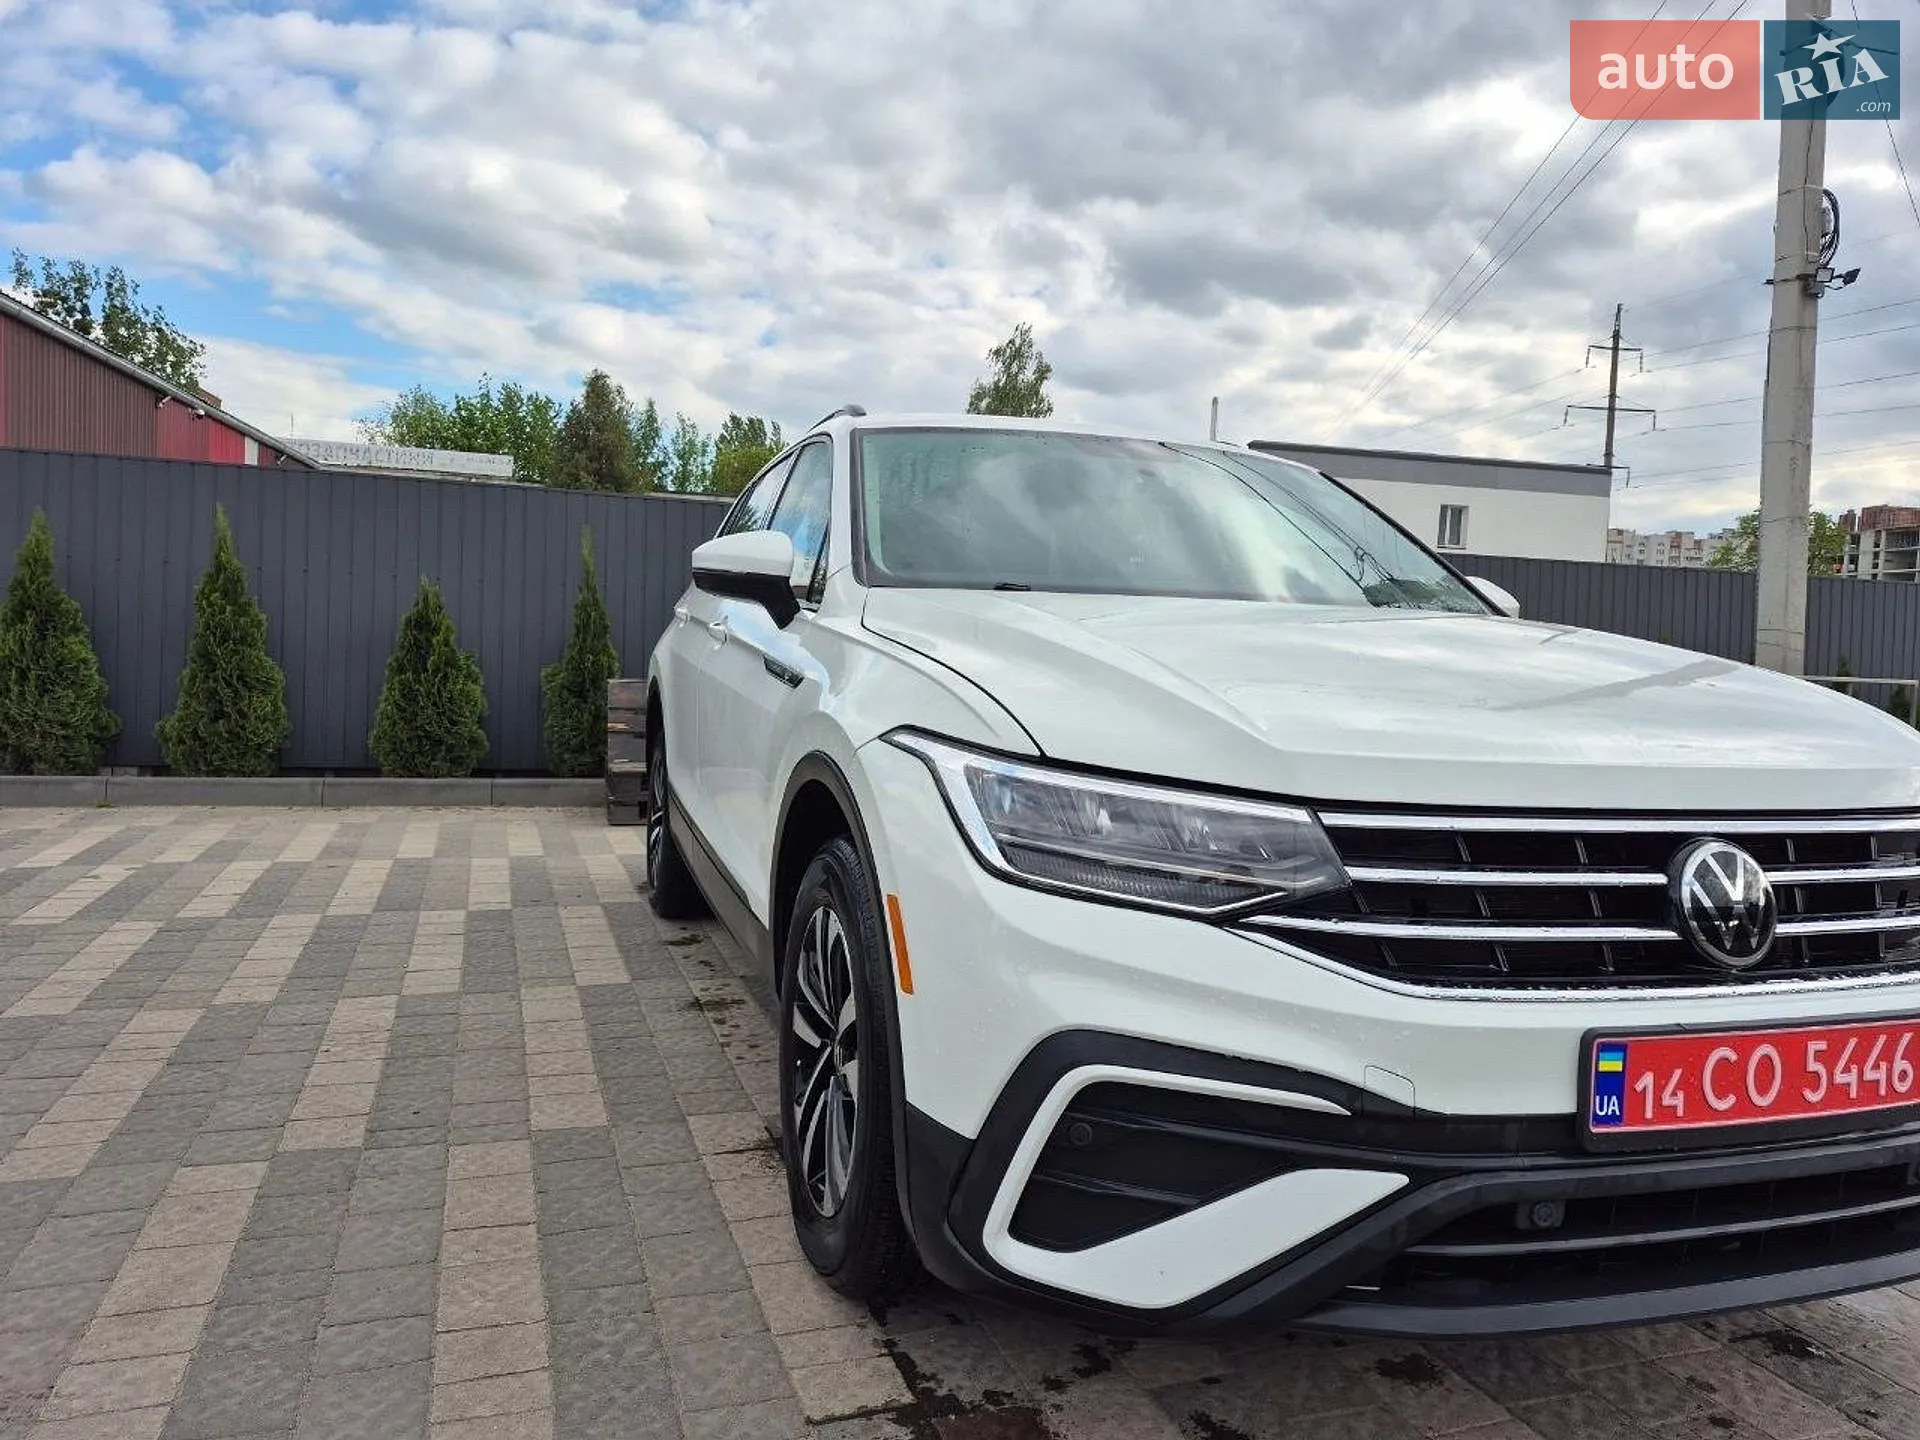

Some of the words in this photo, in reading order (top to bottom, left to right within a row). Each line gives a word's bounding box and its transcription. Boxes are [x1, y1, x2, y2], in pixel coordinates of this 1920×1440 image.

[1633, 1067, 1685, 1119] 14
[1702, 1043, 1782, 1111] CO
[1802, 1031, 1914, 1104] 5446
[1595, 1094, 1620, 1116] UA
